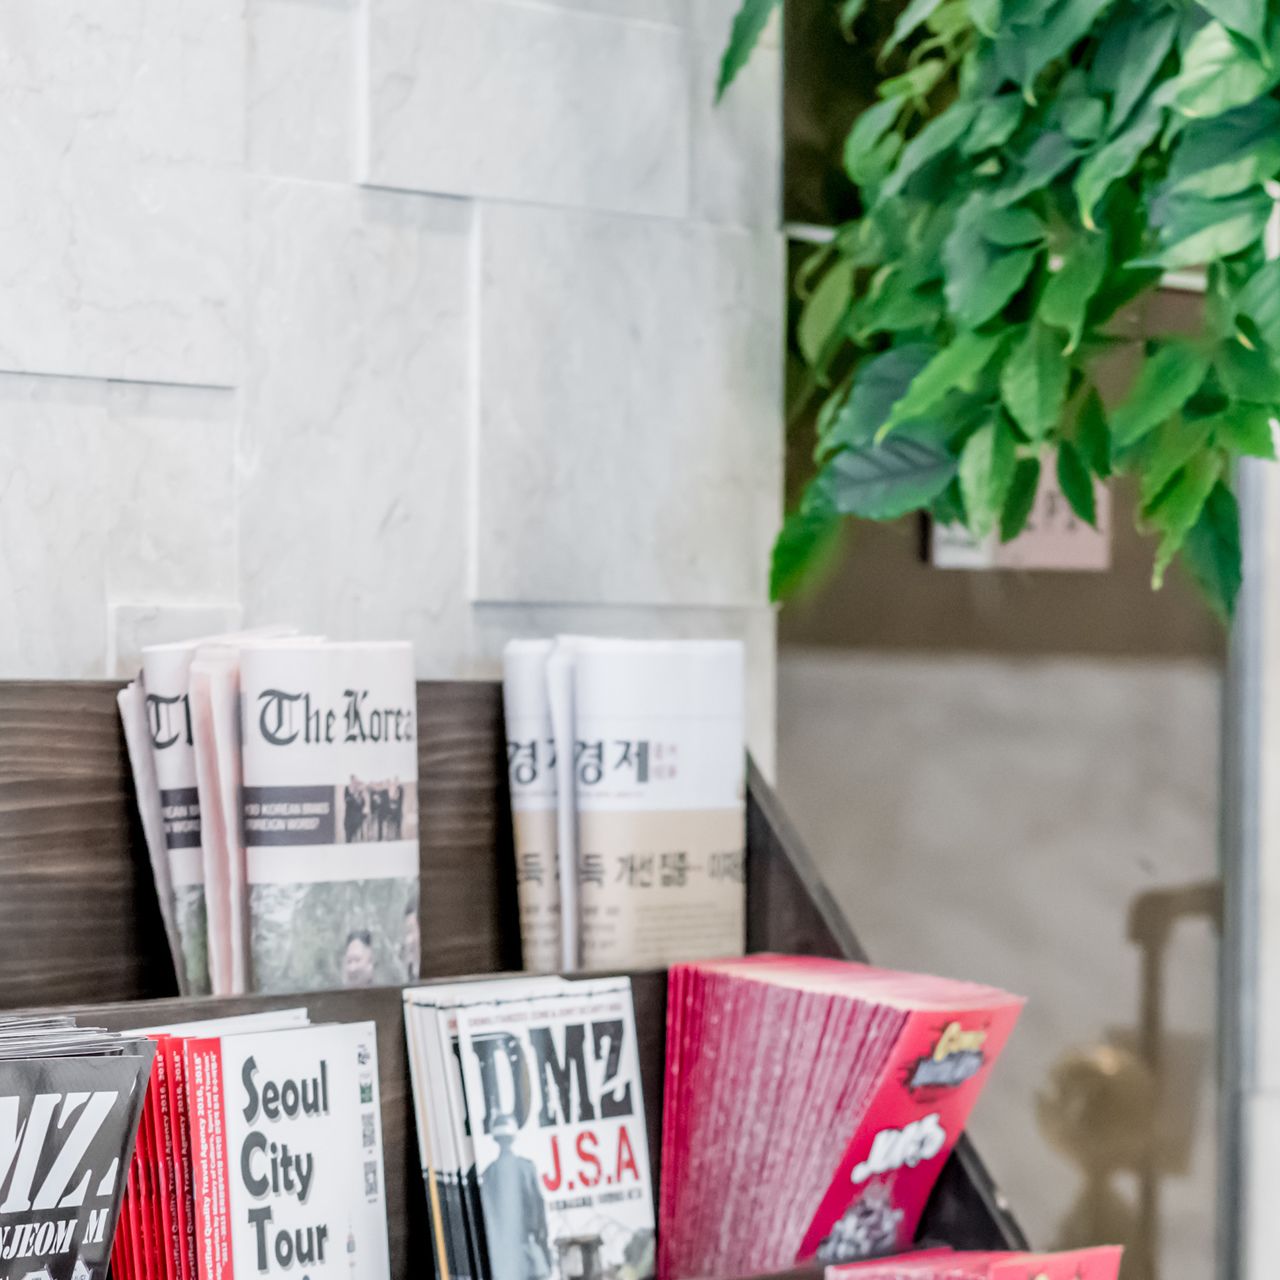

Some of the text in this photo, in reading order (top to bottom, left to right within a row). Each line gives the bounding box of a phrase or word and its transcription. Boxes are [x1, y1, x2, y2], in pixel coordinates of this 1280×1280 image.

[258, 689, 336, 746] The
[242, 1056, 328, 1123] Seoul
[470, 1019, 634, 1135] DMZ
[198, 1118, 207, 1157] Agency
[240, 1130, 313, 1201] City
[543, 1124, 639, 1192] J.S.A
[200, 1160, 209, 1194] Travel
[202, 1196, 212, 1237] Quality
[247, 1205, 328, 1271] Tour
